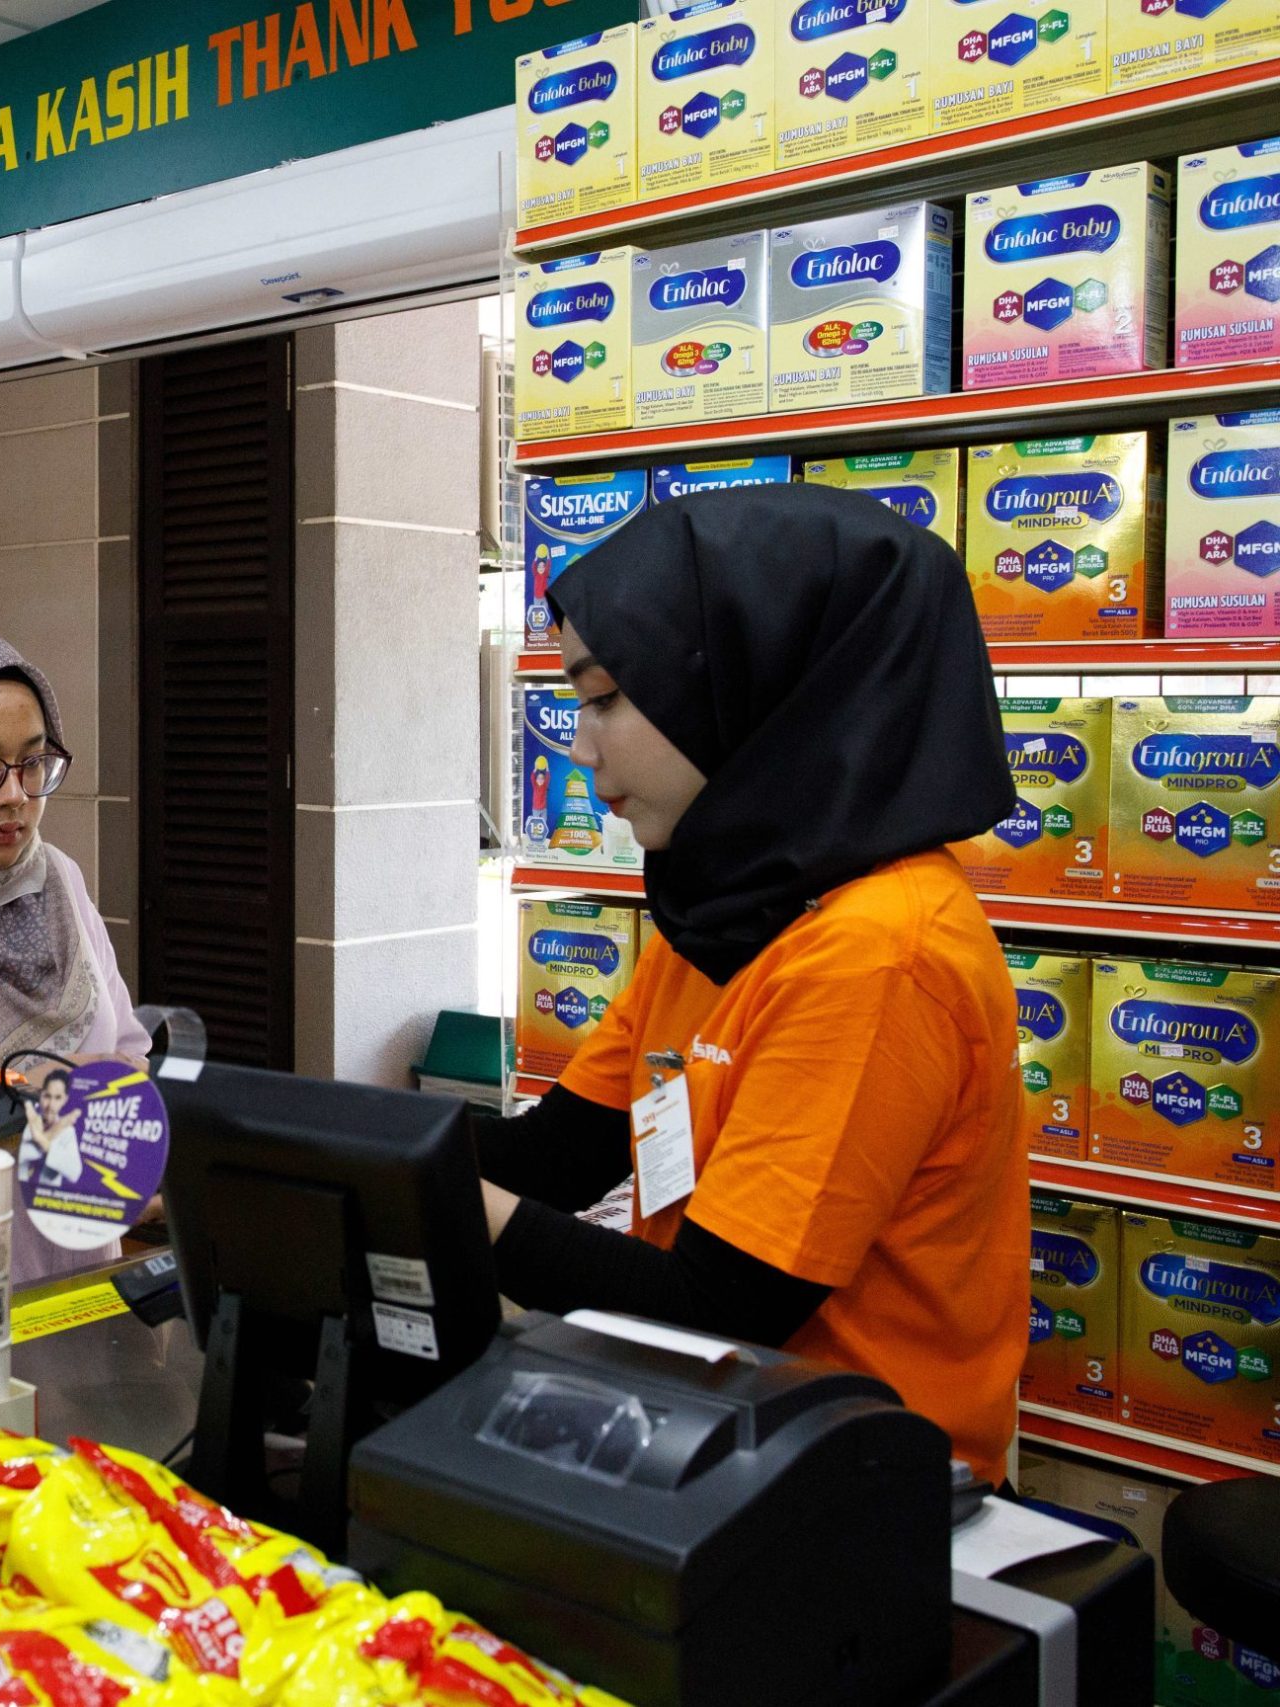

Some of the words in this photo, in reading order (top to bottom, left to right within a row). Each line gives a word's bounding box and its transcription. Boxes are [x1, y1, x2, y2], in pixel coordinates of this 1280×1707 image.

[1147, 0, 1169, 12] ARA
[798, 6, 858, 31] Enfalac
[963, 34, 983, 47] DHA
[991, 29, 1033, 49] MFGM
[658, 49, 706, 71] Enfalac
[710, 34, 748, 58] Baby
[963, 46, 983, 58] ARA
[1113, 43, 1170, 67] RUMUSAN
[1175, 34, 1204, 51] BAYI
[35, 44, 189, 162] KASIH
[207, 0, 418, 106] THANK
[804, 72, 821, 83] DHA
[828, 67, 865, 86] MFGM
[533, 85, 576, 105] Enfalac
[578, 73, 612, 94] Baby
[804, 82, 821, 94] ARA
[934, 88, 985, 110] RUMUSAN
[988, 80, 1014, 98] BAYI
[684, 106, 718, 124] MFGM
[778, 122, 822, 144] RUMUSAN
[825, 116, 848, 134] BAYI
[556, 137, 586, 152] MFGM
[641, 157, 679, 178] RUMUSAN
[682, 152, 702, 169] BAYI
[994, 229, 1057, 250] Enfalac
[1062, 218, 1113, 240] Baby
[806, 253, 884, 280] Enfalac
[1216, 265, 1239, 275] DHA
[261, 271, 300, 286] Dewpoint
[1215, 279, 1238, 290] ARA
[663, 279, 730, 303] Enfalac
[532, 301, 574, 318] Enfalac
[576, 293, 609, 310] Baby
[998, 296, 1018, 305] DHA
[1027, 296, 1069, 311] MFGM
[998, 308, 1018, 318] ARA
[1181, 325, 1226, 342] RUMUSAN
[1230, 319, 1273, 335] SUSULAN
[535, 354, 548, 362] DHA
[554, 355, 582, 367] MFGM
[968, 351, 1008, 366] RUMUSAN
[1010, 347, 1048, 360] SUSULAN
[536, 364, 548, 372] ARA
[774, 370, 816, 385] RUMUSAN
[820, 367, 841, 380] BAYI
[636, 387, 674, 403] RUMUSAN
[676, 386, 695, 399] BAYI
[1199, 465, 1273, 486] Enfalac
[540, 492, 629, 517] SUSTAGEN
[993, 488, 1092, 512] Enfagrow
[561, 515, 604, 527] ALL-IN-ONE
[1018, 516, 1082, 528] MINDPRO
[1205, 536, 1228, 546] DHA
[999, 556, 1020, 566] DHA
[1205, 551, 1228, 560] ARA
[997, 564, 1022, 573] PLUS
[1027, 562, 1070, 575] MFGM
[1108, 578, 1128, 602] 3
[1171, 596, 1218, 610] RUMUSAN
[1221, 594, 1266, 607] SUSULAN
[1140, 744, 1249, 774] Enfagrow
[1167, 777, 1238, 789] MINDPRO
[1145, 823, 1172, 834] PLUS
[1146, 815, 1170, 825] DHA
[1178, 826, 1226, 839] MFGM
[1075, 840, 1093, 864] 3
[533, 937, 600, 962] Enfagrow
[550, 963, 594, 976] MINDPRO
[536, 1000, 553, 1010] PLUS
[537, 994, 552, 1002] DHA
[557, 1004, 586, 1016] MFGM
[1118, 1009, 1224, 1042] Enfagrow
[1145, 1044, 1214, 1062] MIPRO
[1123, 1089, 1149, 1099] PLUS
[1124, 1080, 1147, 1091] DHA
[87, 1096, 142, 1120] WAVE
[1156, 1093, 1201, 1110] MFGM
[1052, 1100, 1069, 1122] 3
[84, 1118, 120, 1136] YOUR
[121, 1120, 163, 1143] CARD
[1243, 1126, 1262, 1150] 3
[1147, 1262, 1250, 1301] Enfagrow
[1174, 1298, 1245, 1321] MINDPRO
[1152, 1342, 1179, 1355] PLUS
[1154, 1334, 1177, 1346] DHA
[1185, 1350, 1232, 1369] MFGM
[1087, 1360, 1103, 1382] 3
